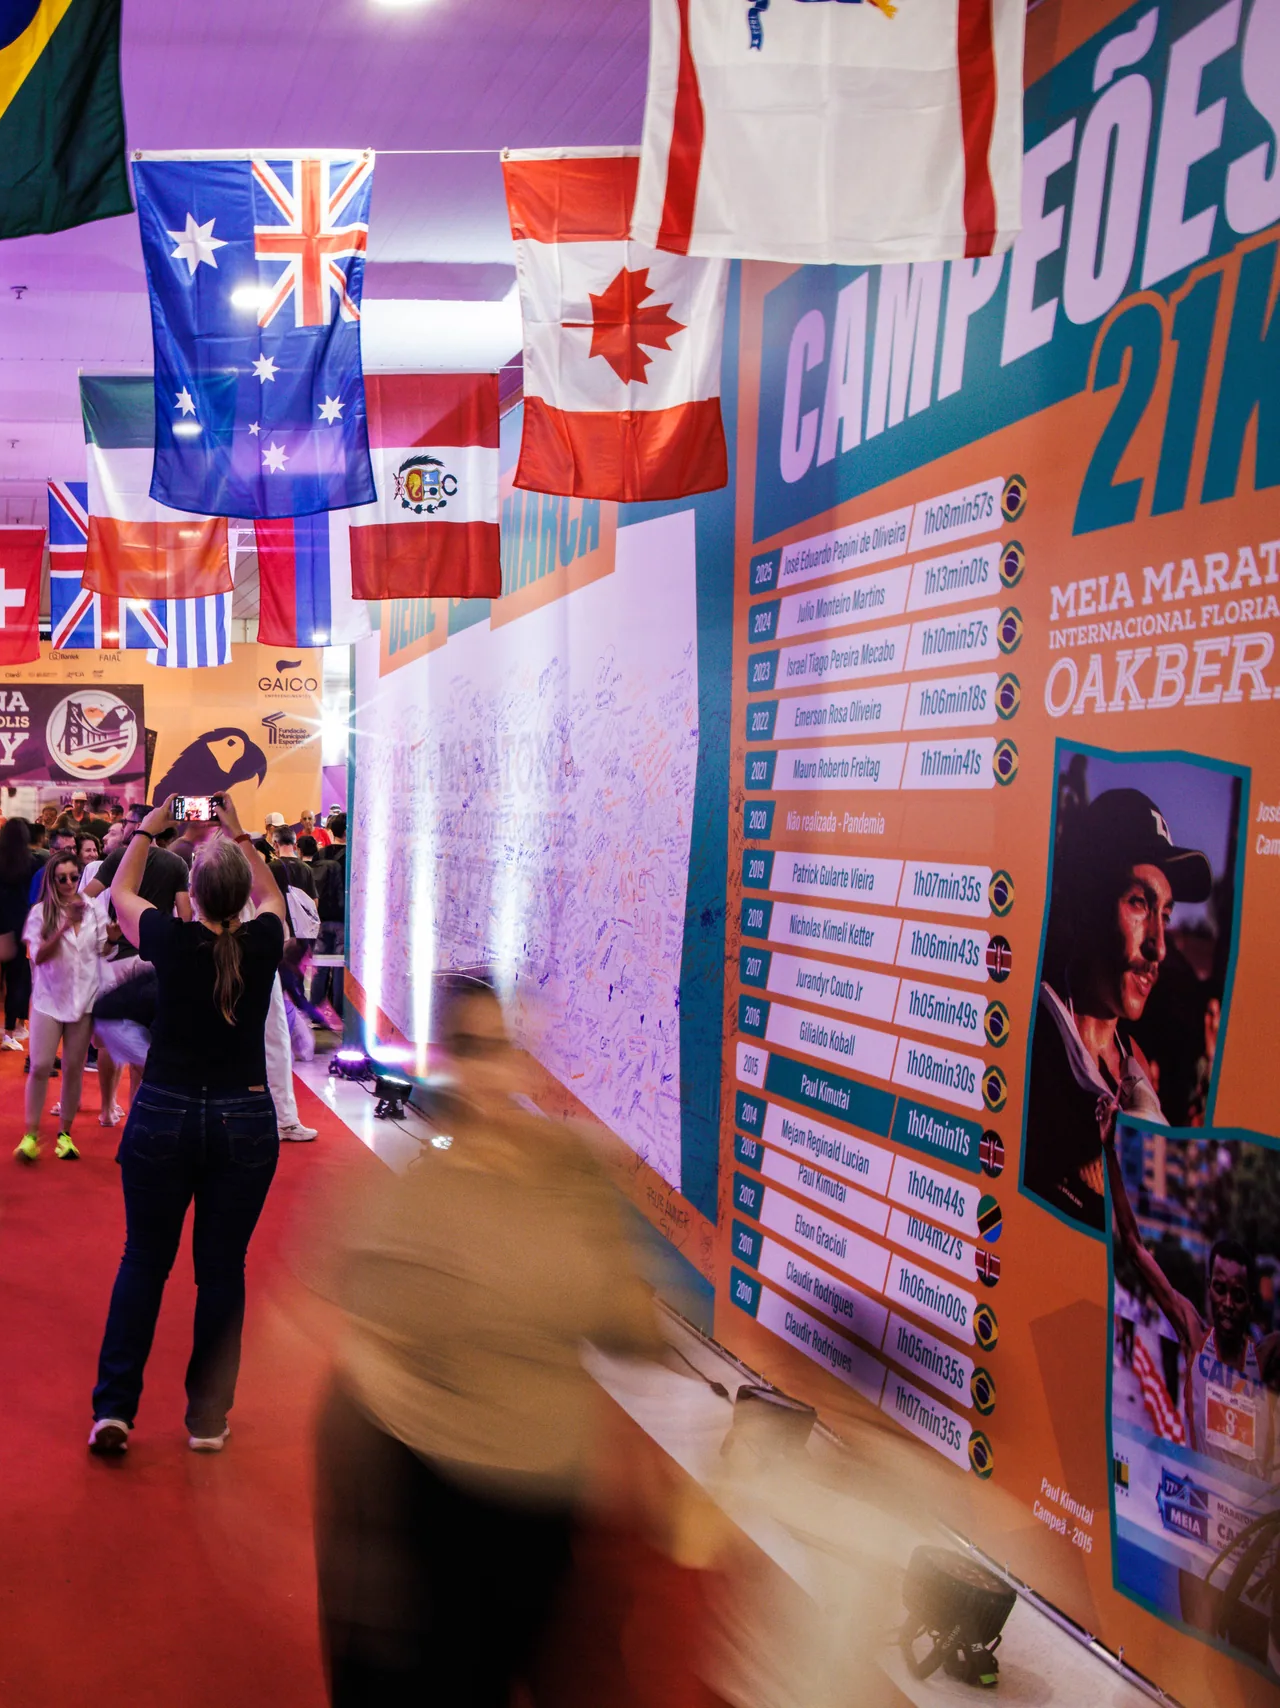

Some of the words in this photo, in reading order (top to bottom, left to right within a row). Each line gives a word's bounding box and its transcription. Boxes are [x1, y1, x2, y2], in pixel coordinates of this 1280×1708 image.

[756, 563, 772, 585] 2025
[784, 554, 799, 576] José
[800, 544, 831, 570] Eduardo
[833, 537, 858, 567] Papini
[860, 533, 870, 551] de
[872, 522, 905, 549] Oliveira
[924, 493, 993, 536] 1h08min57s
[755, 612, 771, 633] 2024
[797, 601, 814, 624] Julio
[816, 593, 850, 622] Monteiro
[852, 587, 885, 613] Martins
[925, 560, 989, 595] 1h13min01s
[1049, 572, 1134, 621] MEIA
[753, 662, 770, 682] 2023
[786, 656, 807, 677] Israel
[808, 651, 829, 676] Tiago
[831, 648, 859, 669] Pereira
[862, 643, 894, 662] Mecabo
[922, 621, 988, 656] 1h10min57s
[1049, 609, 1196, 649] INTERNACIONAL
[258, 677, 318, 691] GAICO
[1044, 631, 1280, 718] OAKBER
[752, 711, 768, 732] 2022
[795, 706, 827, 727] Emerson
[829, 704, 848, 724] Rosa
[850, 701, 881, 722] Oliveira
[920, 685, 987, 716] 1h06min18s
[751, 761, 767, 780] 2021
[793, 759, 816, 779] Mauro
[818, 757, 849, 779] Roberto
[851, 757, 880, 782] Freitag
[921, 748, 982, 777] 1h11min41s
[750, 811, 766, 830] 2020
[786, 811, 801, 832] Não
[803, 811, 836, 833] realizada
[843, 812, 885, 834] Pandemia
[749, 860, 764, 878] 2019
[792, 862, 819, 884] Patrick
[820, 866, 848, 887] Gularte
[850, 868, 874, 891] Vieira
[914, 871, 981, 903] 1h07min35s
[748, 909, 763, 928] 2018
[789, 914, 821, 938] Nicholas
[822, 920, 848, 943] Kimeli
[849, 926, 874, 948] Ketter
[911, 930, 980, 967] 1h06min43s
[746, 958, 761, 976] 2017
[796, 968, 828, 997] Jurandyr
[830, 975, 854, 999] Couto
[855, 982, 863, 1001] Jr
[909, 990, 977, 1030] 1h05min49s
[745, 1006, 760, 1026] 2016
[799, 1021, 828, 1049] Gilialdo
[830, 1028, 855, 1056] Koball
[907, 1049, 975, 1094] 1h08min30s
[743, 1054, 758, 1075] 2015
[801, 1074, 817, 1096] Paul
[818, 1078, 850, 1110] Kimutai
[907, 1112, 970, 1157] 1h04min11s
[742, 1102, 757, 1124] 2014
[781, 1119, 806, 1149] Mejam
[808, 1130, 840, 1166] Reginald
[842, 1146, 870, 1176] Lucian
[908, 1171, 965, 1218] 1h04m44s
[739, 1185, 754, 1208] 2012
[794, 1214, 814, 1240] Elson
[816, 1224, 847, 1259] Gracioli
[900, 1268, 966, 1327] 1h06min00s
[738, 1232, 753, 1256] 2011
[786, 1261, 812, 1291] Claudir
[814, 1277, 854, 1318] Rodrigues
[897, 1326, 964, 1389] 1h05min35s
[737, 1279, 752, 1304] 2010
[784, 1311, 811, 1343] Claudir
[812, 1326, 852, 1372] Rodrigues
[895, 1386, 961, 1451] 1h07min35s
[1040, 1477, 1061, 1502] Paul
[1060, 1490, 1094, 1526] Kimutai
[1170, 1508, 1202, 1536] MEIA
[1072, 1526, 1094, 1554] 2015
